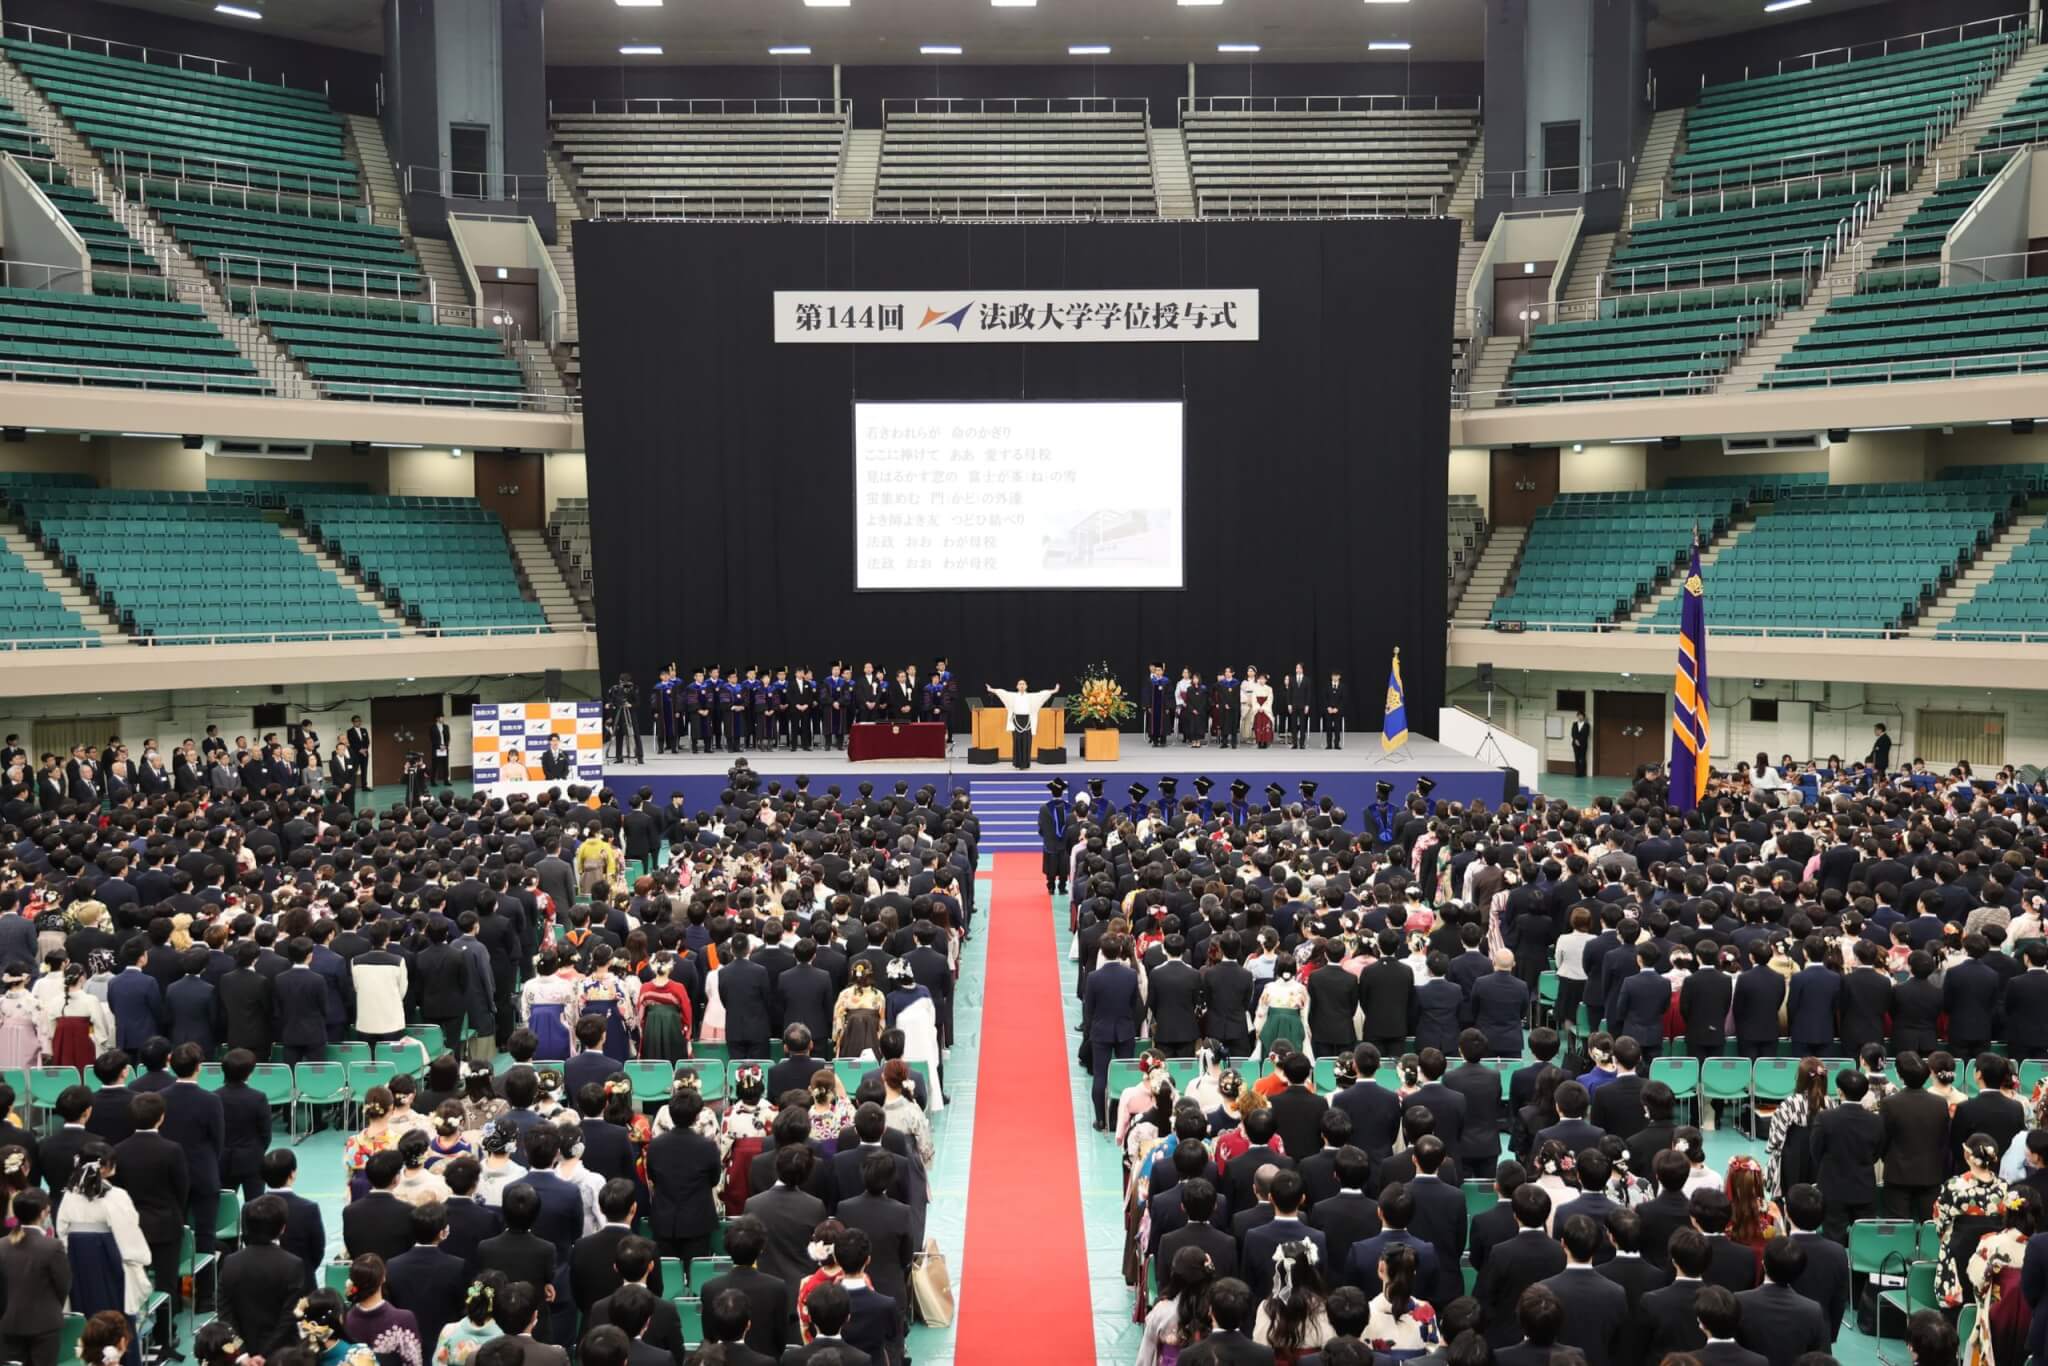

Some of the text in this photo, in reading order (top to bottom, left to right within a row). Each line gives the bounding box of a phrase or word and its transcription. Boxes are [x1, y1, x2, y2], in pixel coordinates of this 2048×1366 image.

[796, 302, 1238, 331] 第144回 法政大学学位授与式
